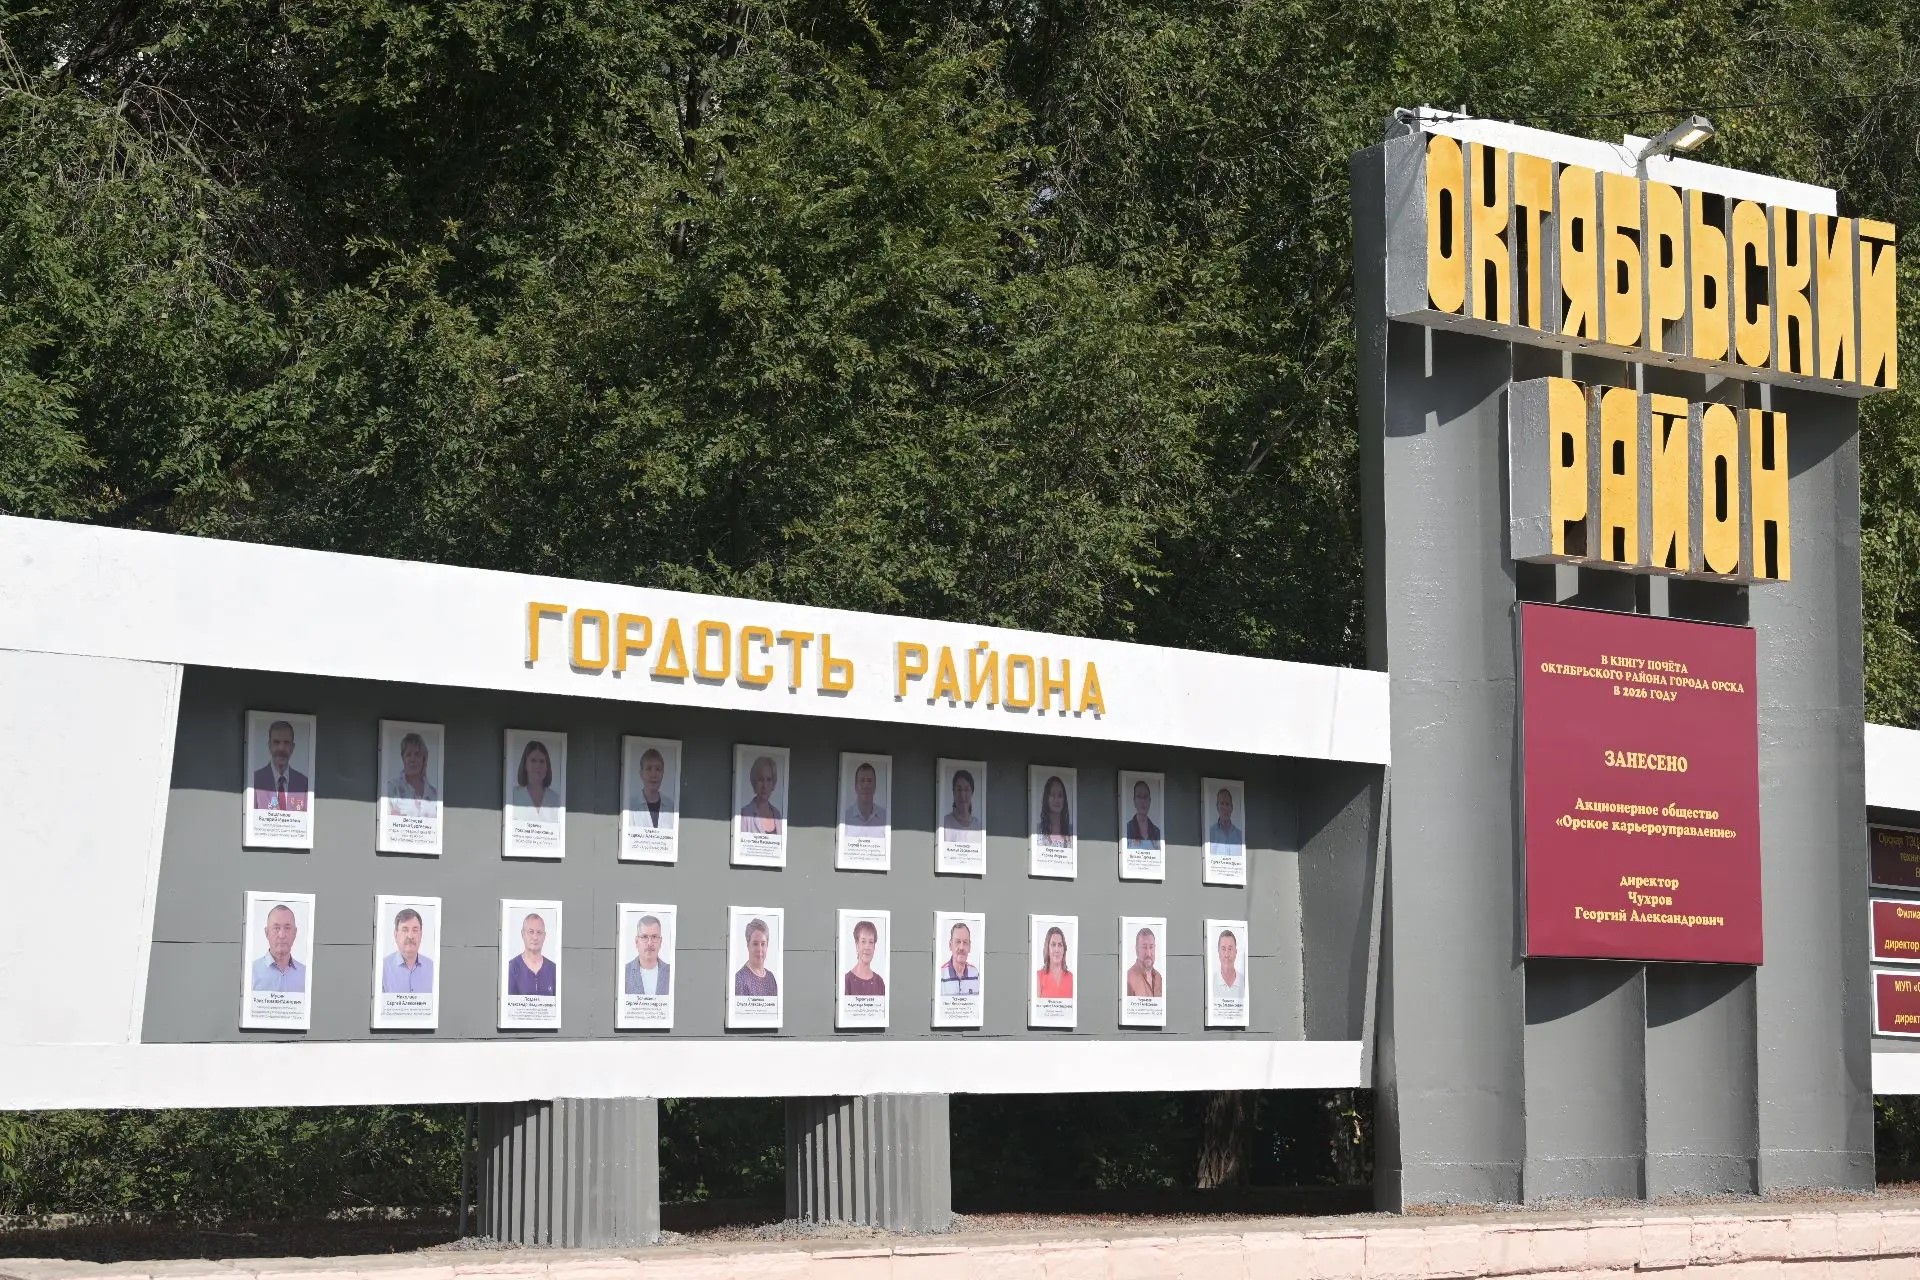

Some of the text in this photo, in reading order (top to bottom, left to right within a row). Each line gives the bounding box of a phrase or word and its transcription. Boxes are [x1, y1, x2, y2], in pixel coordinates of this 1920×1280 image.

[1425, 134, 1897, 389] ОКТЯБРЬСКИЙ
[1548, 376, 1791, 581] РАЙОН
[526, 602, 1106, 716] ГОРДОСТЬ РАЙОНА
[1601, 655, 1688, 674] В КНИГУ ПОЧЁТА
[1541, 662, 1744, 693] ОКТЯБРЬСКОГО РАЙОНА ГОРОДА ОРСКА
[1613, 686, 1677, 701] В 2026 ГОДУ
[1604, 750, 1688, 772] ЗАНЕСЕНО
[1575, 797, 1719, 820] Акционерное общество
[1556, 815, 1736, 839] «Орское карьероуправление»
[1620, 875, 1679, 890] директор
[1628, 891, 1673, 907] Чухров
[1575, 907, 1724, 927] Георгий Александрович
[1896, 907, 1920, 919] Филиа
[1895, 1013, 1920, 1025] директ
